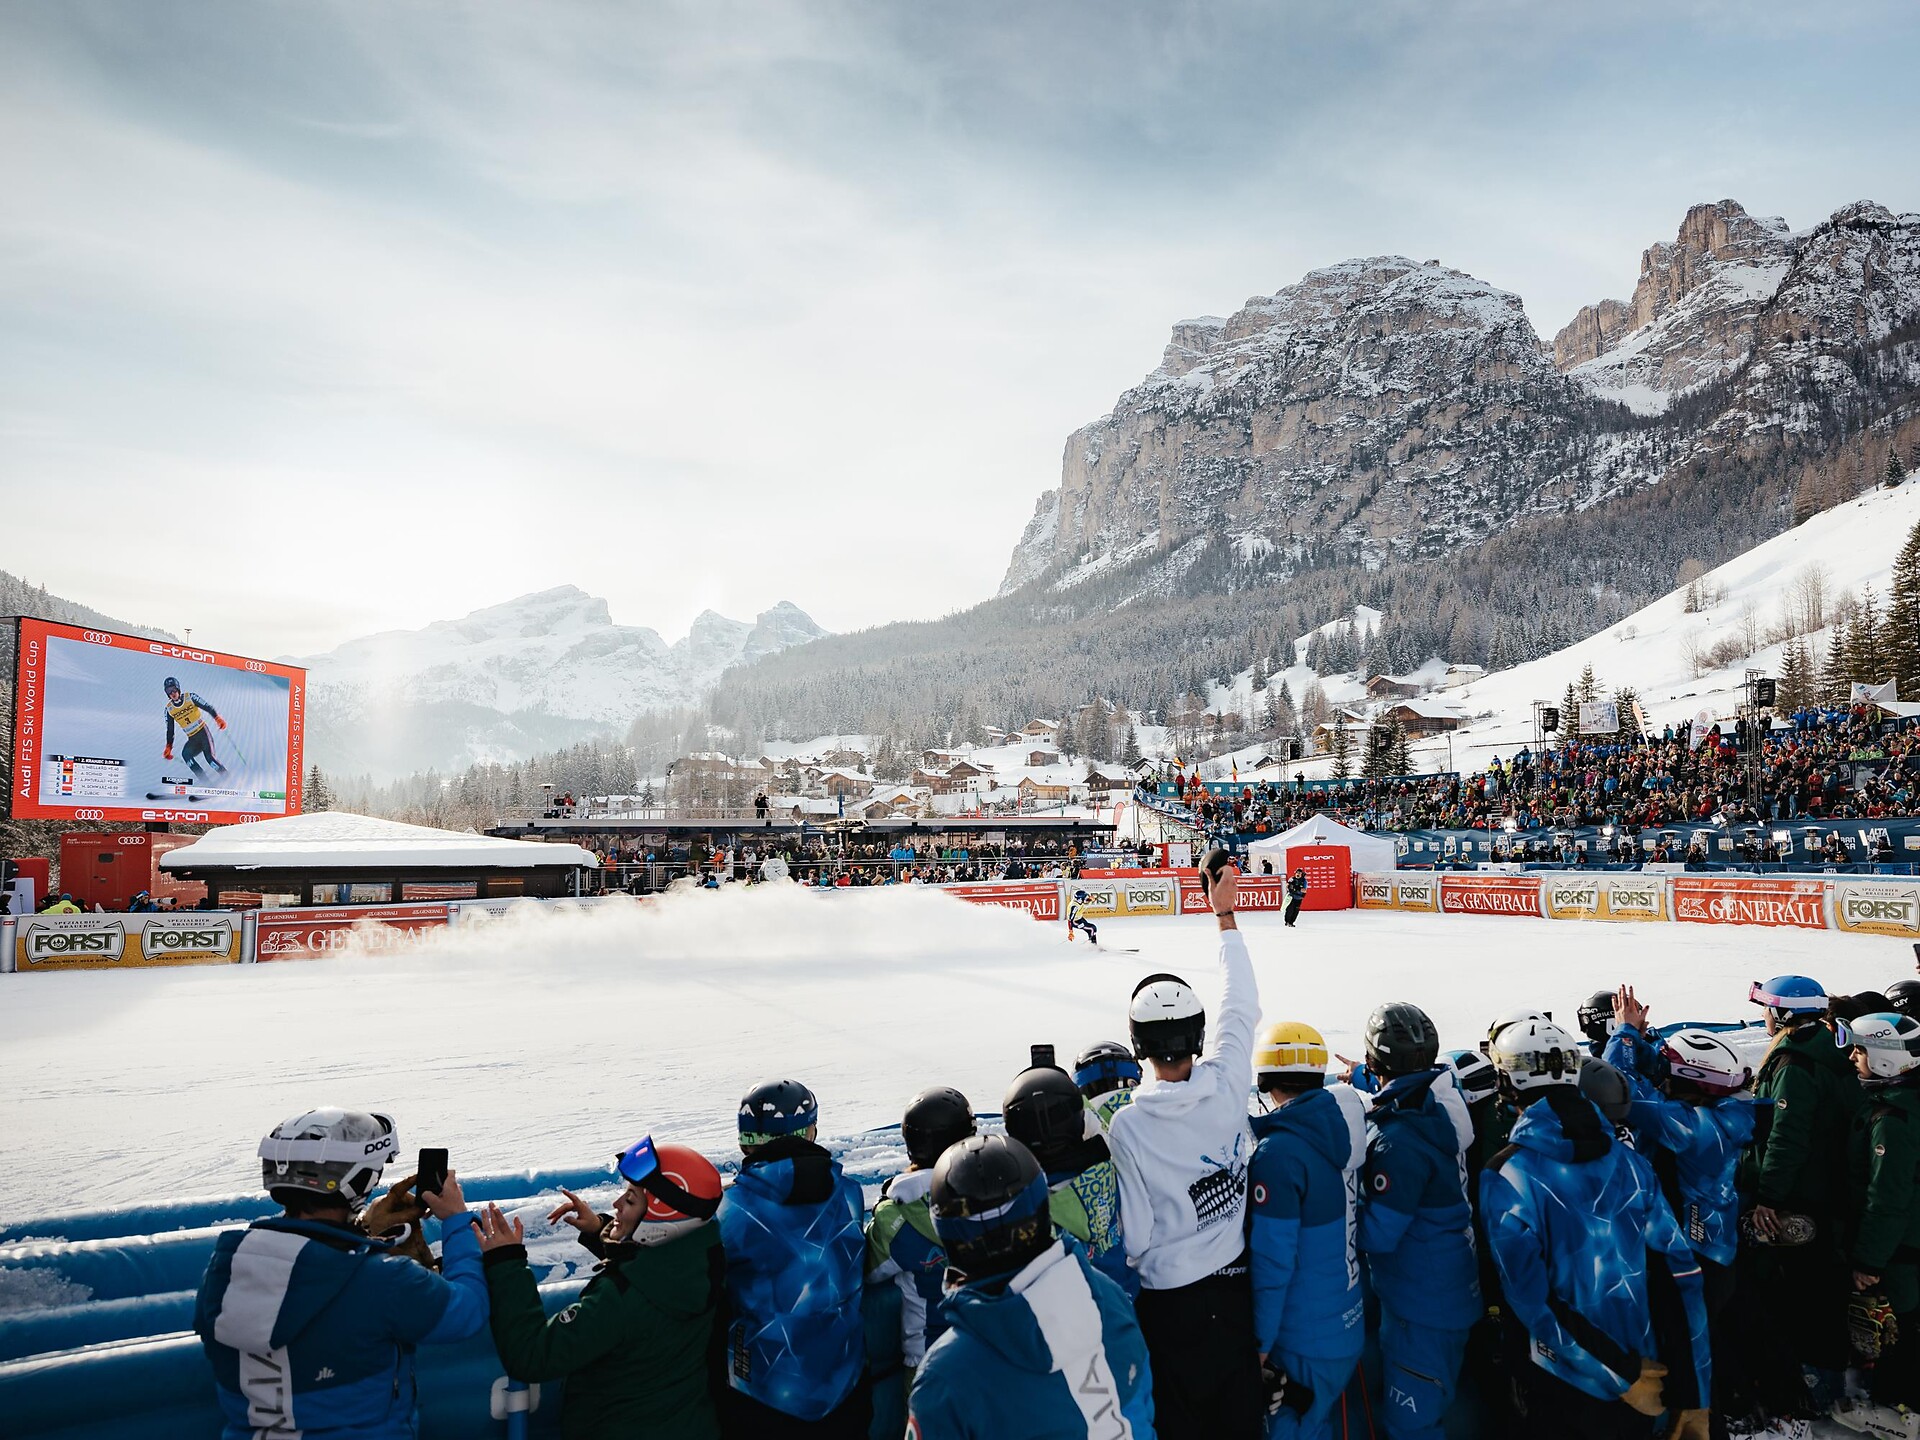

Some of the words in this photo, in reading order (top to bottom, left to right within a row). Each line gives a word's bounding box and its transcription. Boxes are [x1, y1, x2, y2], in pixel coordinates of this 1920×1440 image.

[26, 640, 40, 666] Cup
[149, 644, 214, 664] e-tron
[24, 670, 36, 712] World
[24, 716, 34, 734] Ski
[22, 740, 33, 762] FIS
[20, 765, 32, 798] Audi
[142, 810, 208, 821] e-tron
[1129, 891, 1166, 903] FORST
[1234, 890, 1280, 907] NERALI
[1363, 885, 1389, 897] FORST
[1400, 887, 1429, 900] FORST
[1554, 890, 1596, 905] FORST
[1612, 891, 1655, 906] FORST
[1464, 892, 1538, 912] GENERALI
[1848, 900, 1913, 920] FORST
[1710, 898, 1821, 925] GENERALI
[34, 933, 118, 952] FORST
[150, 931, 226, 949] FORST
[364, 1138, 391, 1155] POC
[1865, 1421, 1907, 1439] HEAD
